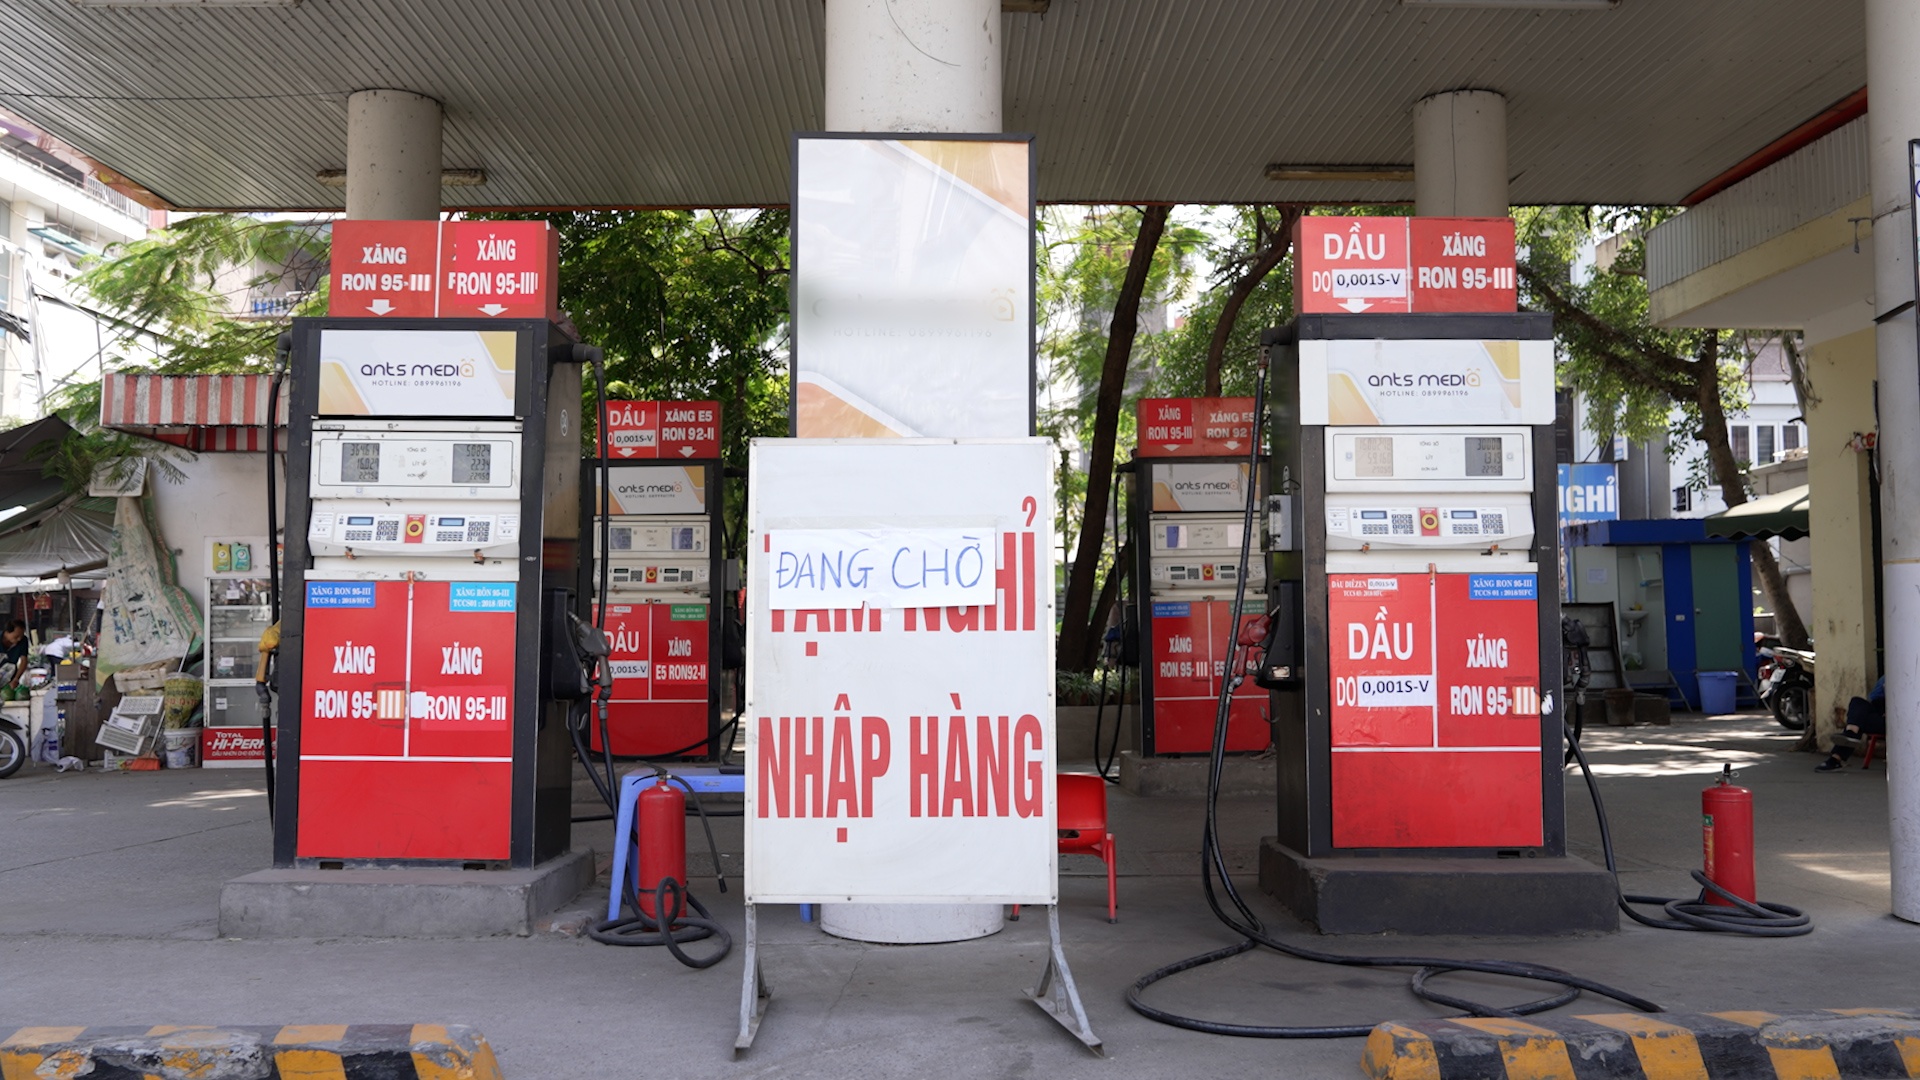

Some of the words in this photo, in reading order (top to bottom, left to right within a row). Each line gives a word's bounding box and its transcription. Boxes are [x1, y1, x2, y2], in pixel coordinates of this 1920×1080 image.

[477, 234, 516, 261] XĂNG
[1324, 222, 1385, 260] DẦU
[1442, 232, 1486, 257] XĂNG
[361, 243, 407, 264] XĂNG
[342, 274, 376, 291] RON
[457, 272, 491, 294] RON
[496, 272, 535, 294] 95-III
[1312, 271, 1331, 292] DO
[1337, 273, 1400, 288] 0,001S-V
[1418, 266, 1457, 289] RON
[1462, 266, 1513, 289] 95-III
[361, 361, 406, 376] ants
[1368, 372, 1413, 387] ants
[610, 404, 645, 426] DẦU
[665, 408, 696, 422] XĂNG
[698, 410, 713, 422] E5
[1158, 405, 1181, 420] XĂNG
[1210, 411, 1239, 423] XĂNG
[662, 427, 686, 441] RON
[688, 427, 714, 441] 92-II
[1148, 426, 1168, 439] RON
[1207, 427, 1230, 438] RON
[776, 548, 874, 590] ĐANG
[892, 535, 983, 589] CHỜ
[904, 495, 1037, 633] HỈ
[312, 586, 333, 596] XĂNG
[1474, 577, 1495, 588] XĂNG
[1169, 634, 1192, 653] XĂNG
[1348, 606, 1413, 660] DẦU
[668, 637, 691, 656] XĂNG
[1466, 633, 1508, 668] XĂNG
[332, 641, 375, 674] XĂNG
[440, 642, 483, 675] XĂNG
[656, 665, 667, 680] E5
[1160, 661, 1179, 677] RON
[1336, 676, 1356, 706] DO
[1362, 680, 1429, 696] 0,001S-V
[1450, 685, 1483, 715] RON
[1486, 685, 1536, 715] 95-III
[314, 690, 347, 719] RON
[424, 696, 460, 720] RON
[465, 696, 506, 720] 95-III
[758, 693, 891, 842] NHẬP
[910, 693, 1043, 819] HÀNG
